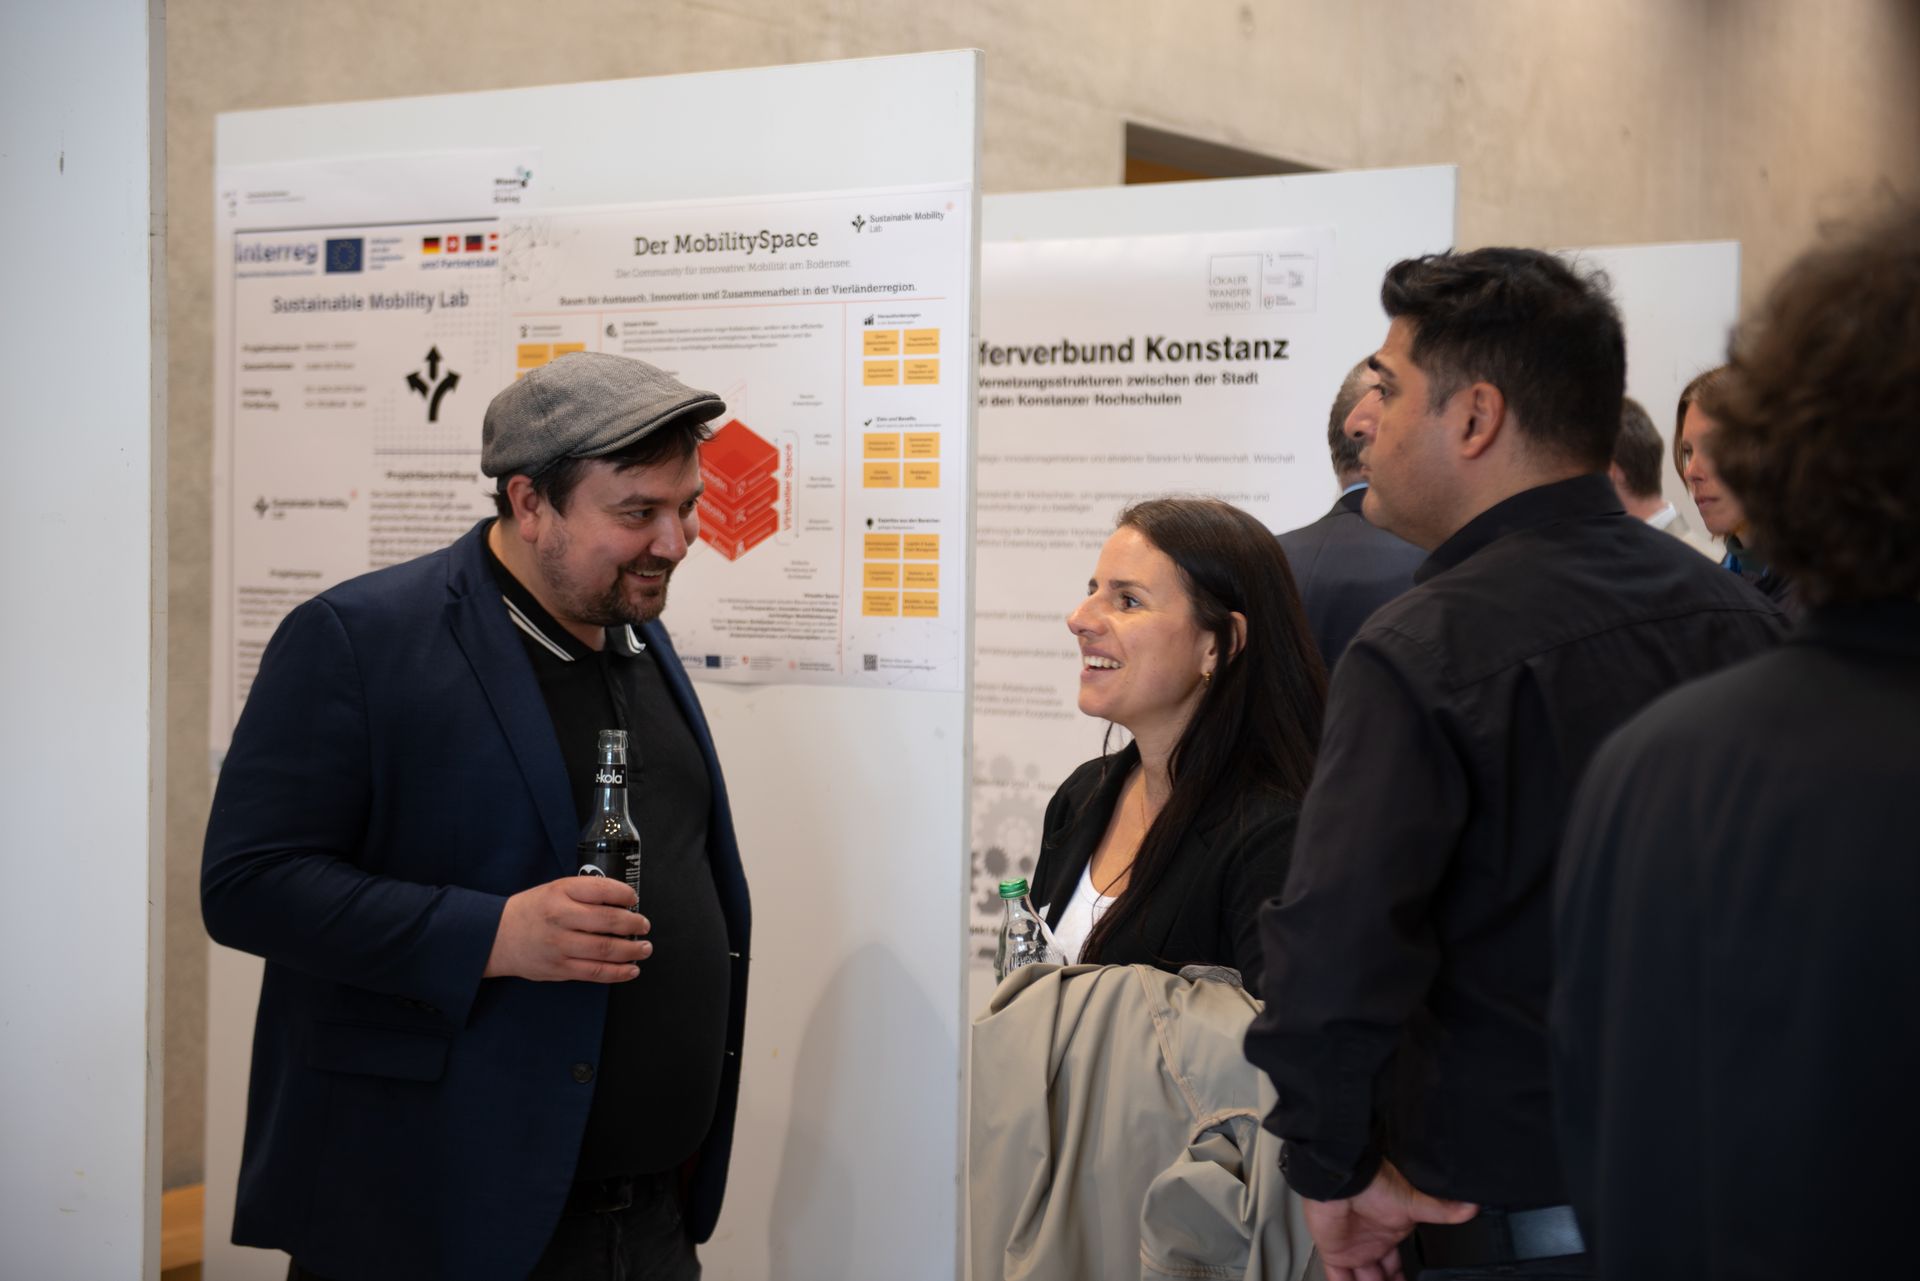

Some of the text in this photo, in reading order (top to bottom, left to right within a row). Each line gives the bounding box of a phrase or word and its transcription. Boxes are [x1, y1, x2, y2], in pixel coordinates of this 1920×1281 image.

[869, 211, 945, 223] Sustainable Mobility
[869, 224, 883, 233] Lab
[634, 229, 819, 256] Der MobilitySpace
[632, 266, 682, 278] Community
[748, 262, 787, 273] Mobilität
[789, 263, 804, 271] am
[651, 291, 700, 303] Innovation
[702, 290, 719, 300] und
[722, 287, 800, 300] Zusammenarbeit
[803, 286, 812, 295] in
[814, 285, 829, 295] der
[832, 282, 917, 296] Vierländerregion.
[1209, 288, 1251, 298] TRANSFER
[272, 288, 469, 314] Sustainable Mobility Lab
[1208, 301, 1251, 312] VERBUND
[1145, 335, 1290, 363] Konstanz
[1127, 373, 1190, 388] zwischen
[1194, 373, 1217, 386] der
[1222, 371, 1259, 386] Stadt
[991, 395, 1014, 407] den
[1018, 394, 1090, 407] Konstanzer
[1095, 392, 1182, 407] Hochschulen
[784, 442, 793, 478] Space
[1254, 453, 1296, 464] Wirtschaft
